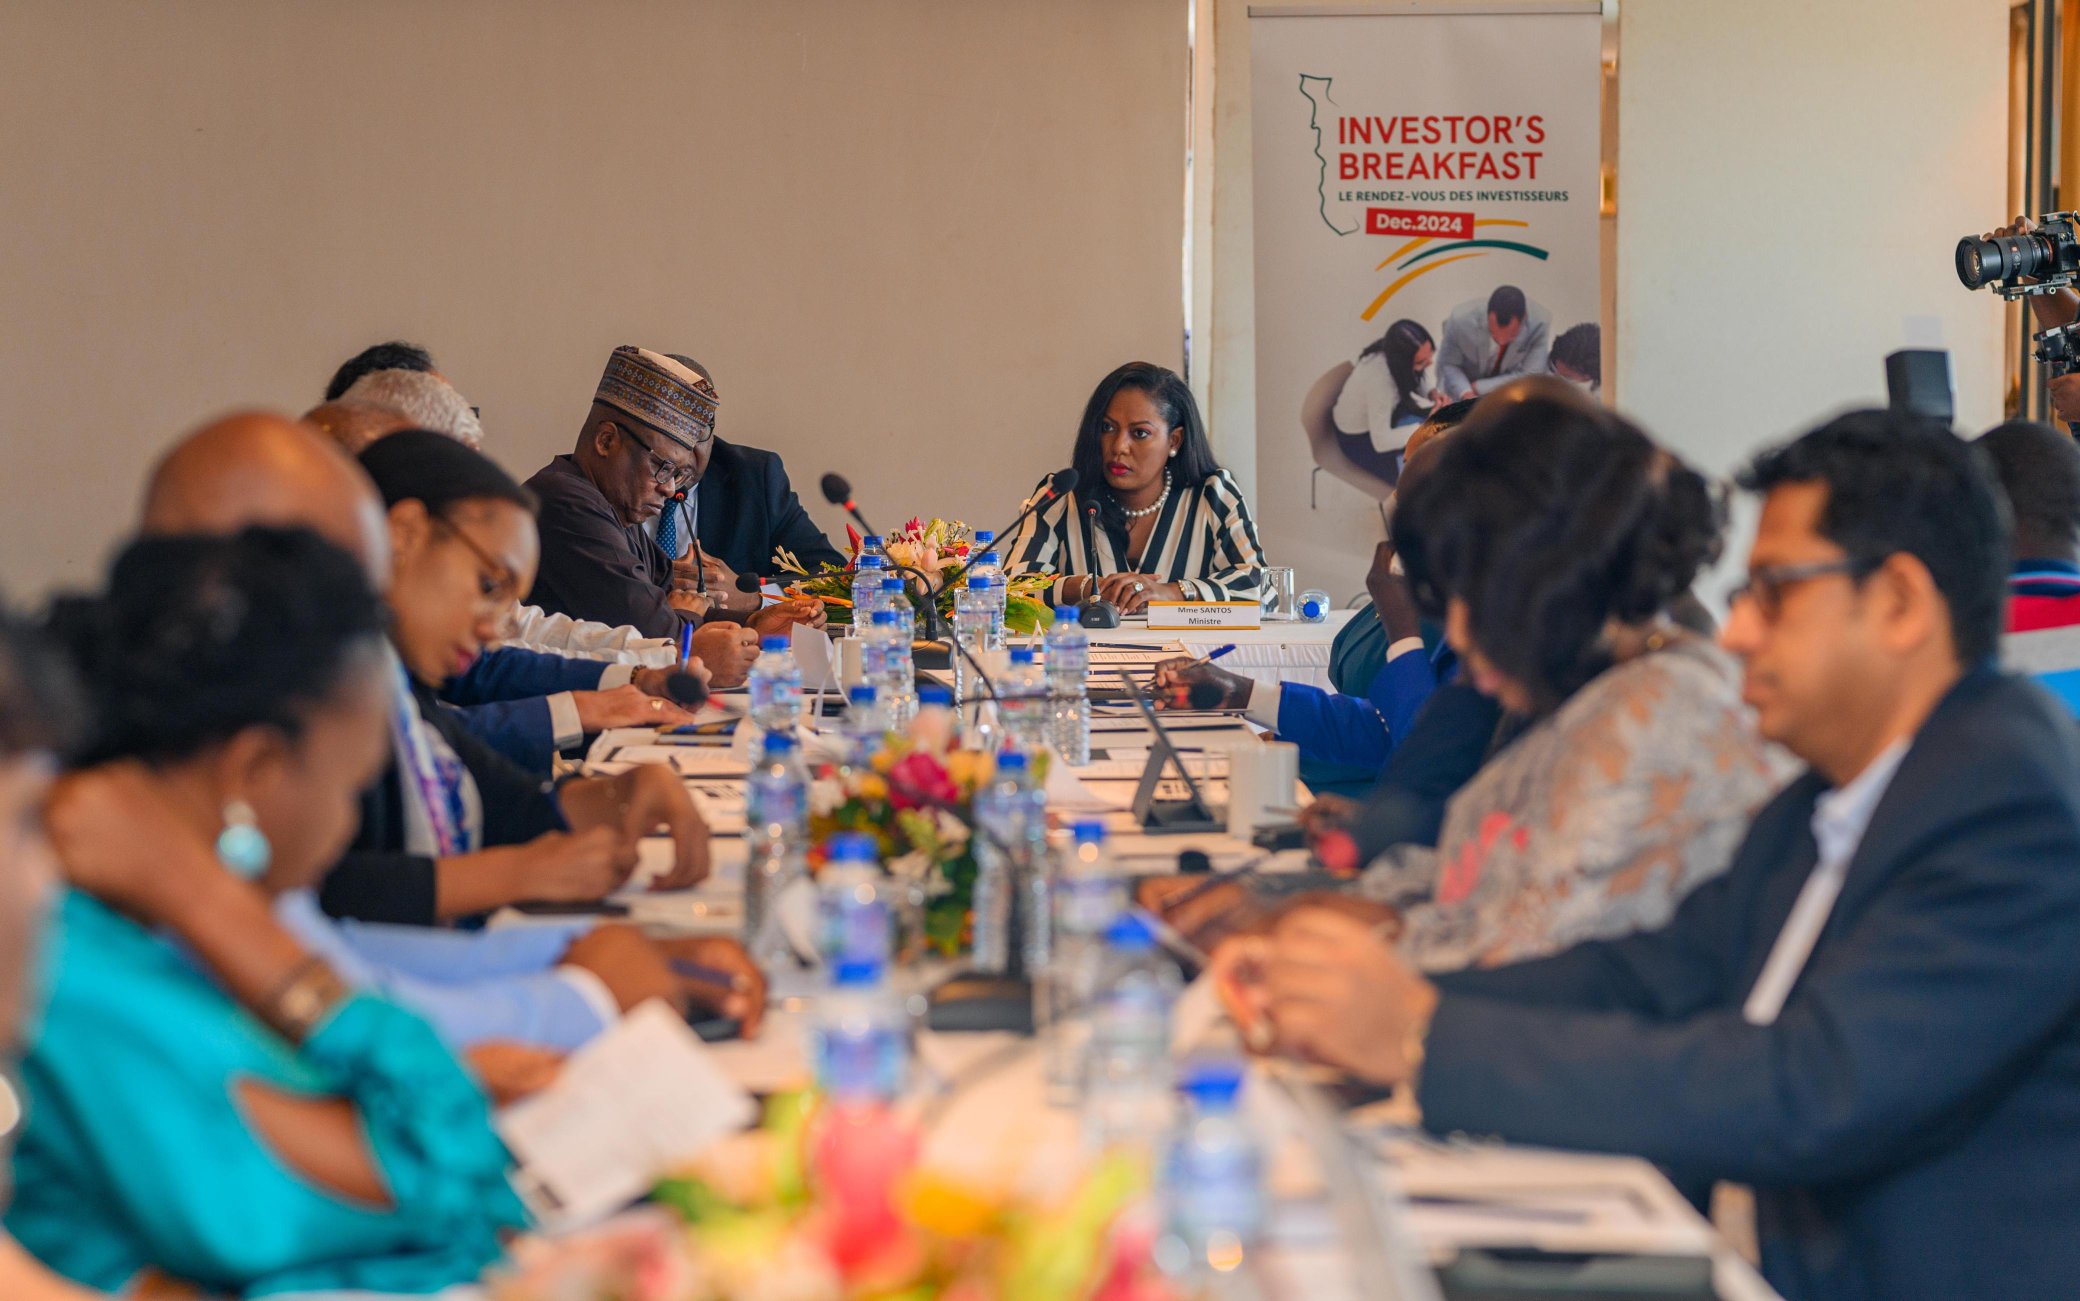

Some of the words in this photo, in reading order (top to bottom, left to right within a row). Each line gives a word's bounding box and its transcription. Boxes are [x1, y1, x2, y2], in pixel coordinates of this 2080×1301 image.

[1338, 115, 1546, 145] INVESTOR'S
[1338, 151, 1544, 180] BREAKFAST
[1338, 191, 1353, 202] LE
[1356, 191, 1446, 202] RENDEZ-VOUS
[1449, 191, 1474, 202] DES
[1476, 191, 1569, 202] INVESTISSEURS
[1376, 213, 1463, 233] Dec.2024
[1188, 617, 1222, 625] Ministre
